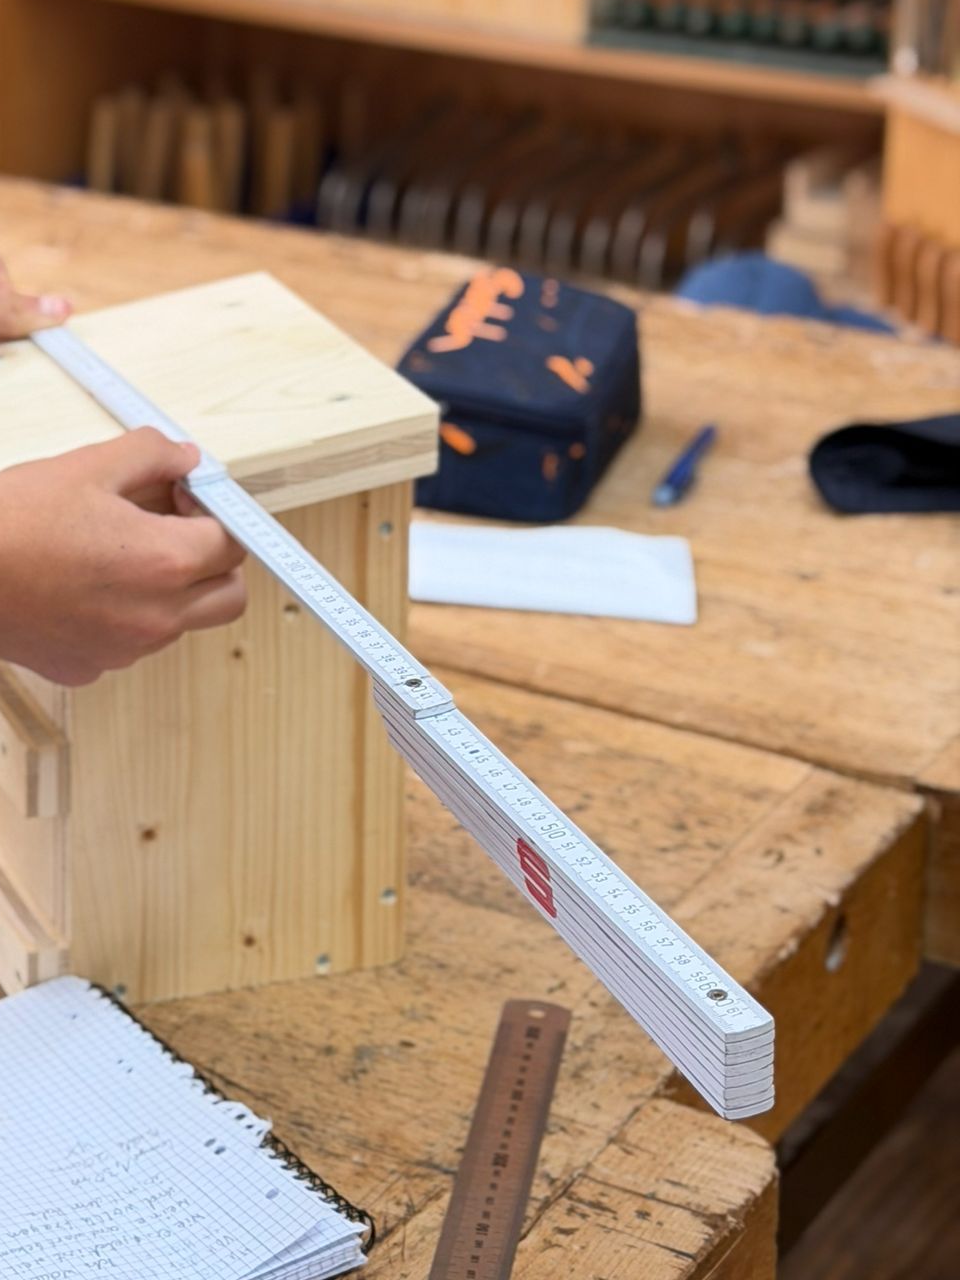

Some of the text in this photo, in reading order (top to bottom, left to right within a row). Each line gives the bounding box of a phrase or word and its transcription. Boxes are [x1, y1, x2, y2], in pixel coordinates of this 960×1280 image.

[488, 768, 503, 777] 46
[517, 797, 532, 806] 48
[531, 812, 546, 820] 49
[540, 823, 566, 839] 50
[561, 841, 576, 851] 51
[576, 856, 592, 867] 52
[591, 872, 608, 883] 53
[607, 888, 623, 899] 54
[623, 904, 640, 915] 55
[640, 920, 657, 932] 56
[656, 937, 674, 947] 57
[673, 954, 691, 966] 58
[690, 971, 708, 983] 59
[726, 1007, 743, 1017] 61
